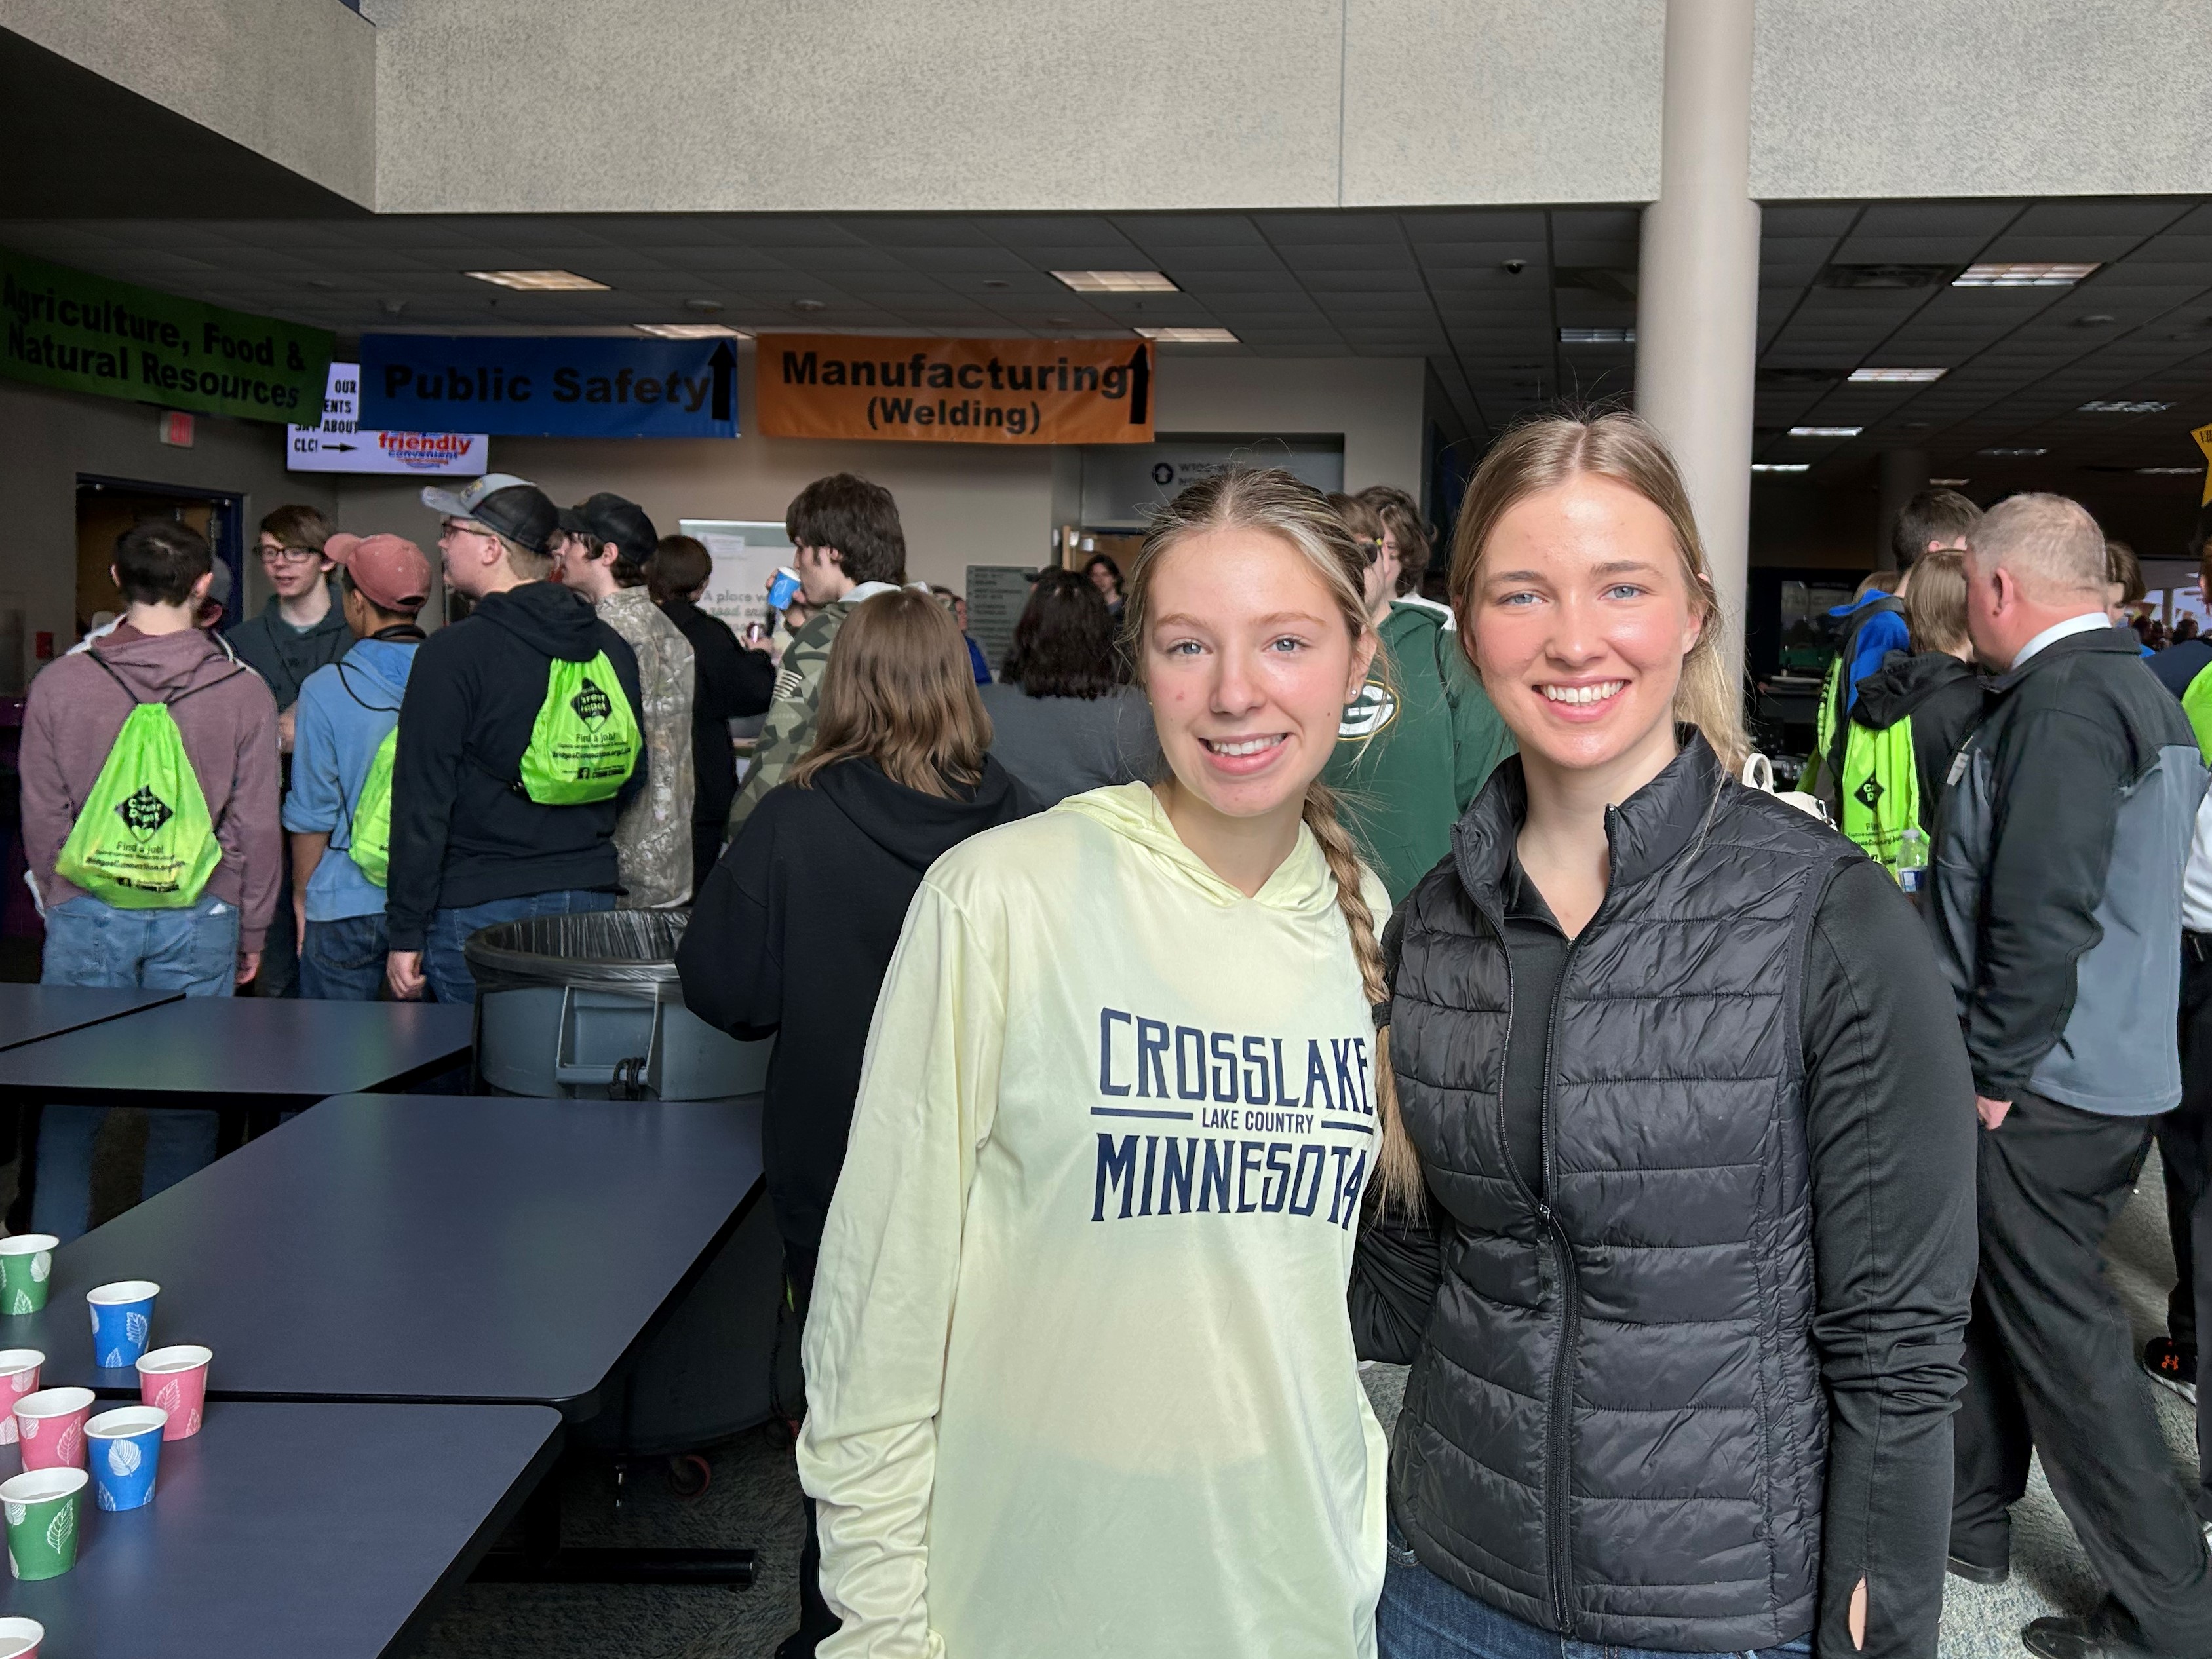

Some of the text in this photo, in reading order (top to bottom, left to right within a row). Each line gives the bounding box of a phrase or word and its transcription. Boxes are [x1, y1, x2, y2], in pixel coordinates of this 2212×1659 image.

[3, 272, 306, 371] Agriculture, Food &
[9, 322, 300, 409] Natural Resources
[384, 364, 711, 413] Public Safety
[782, 351, 1127, 398] Manufacturing
[323, 398, 351, 414] ENTS
[867, 396, 1040, 435] (Welding)
[378, 431, 471, 456] friendly
[1098, 1006, 1374, 1116] CROSSLAKE
[1201, 1107, 1314, 1134] LAKE COUNTRY
[1090, 1132, 1367, 1231] MINNESOTA
